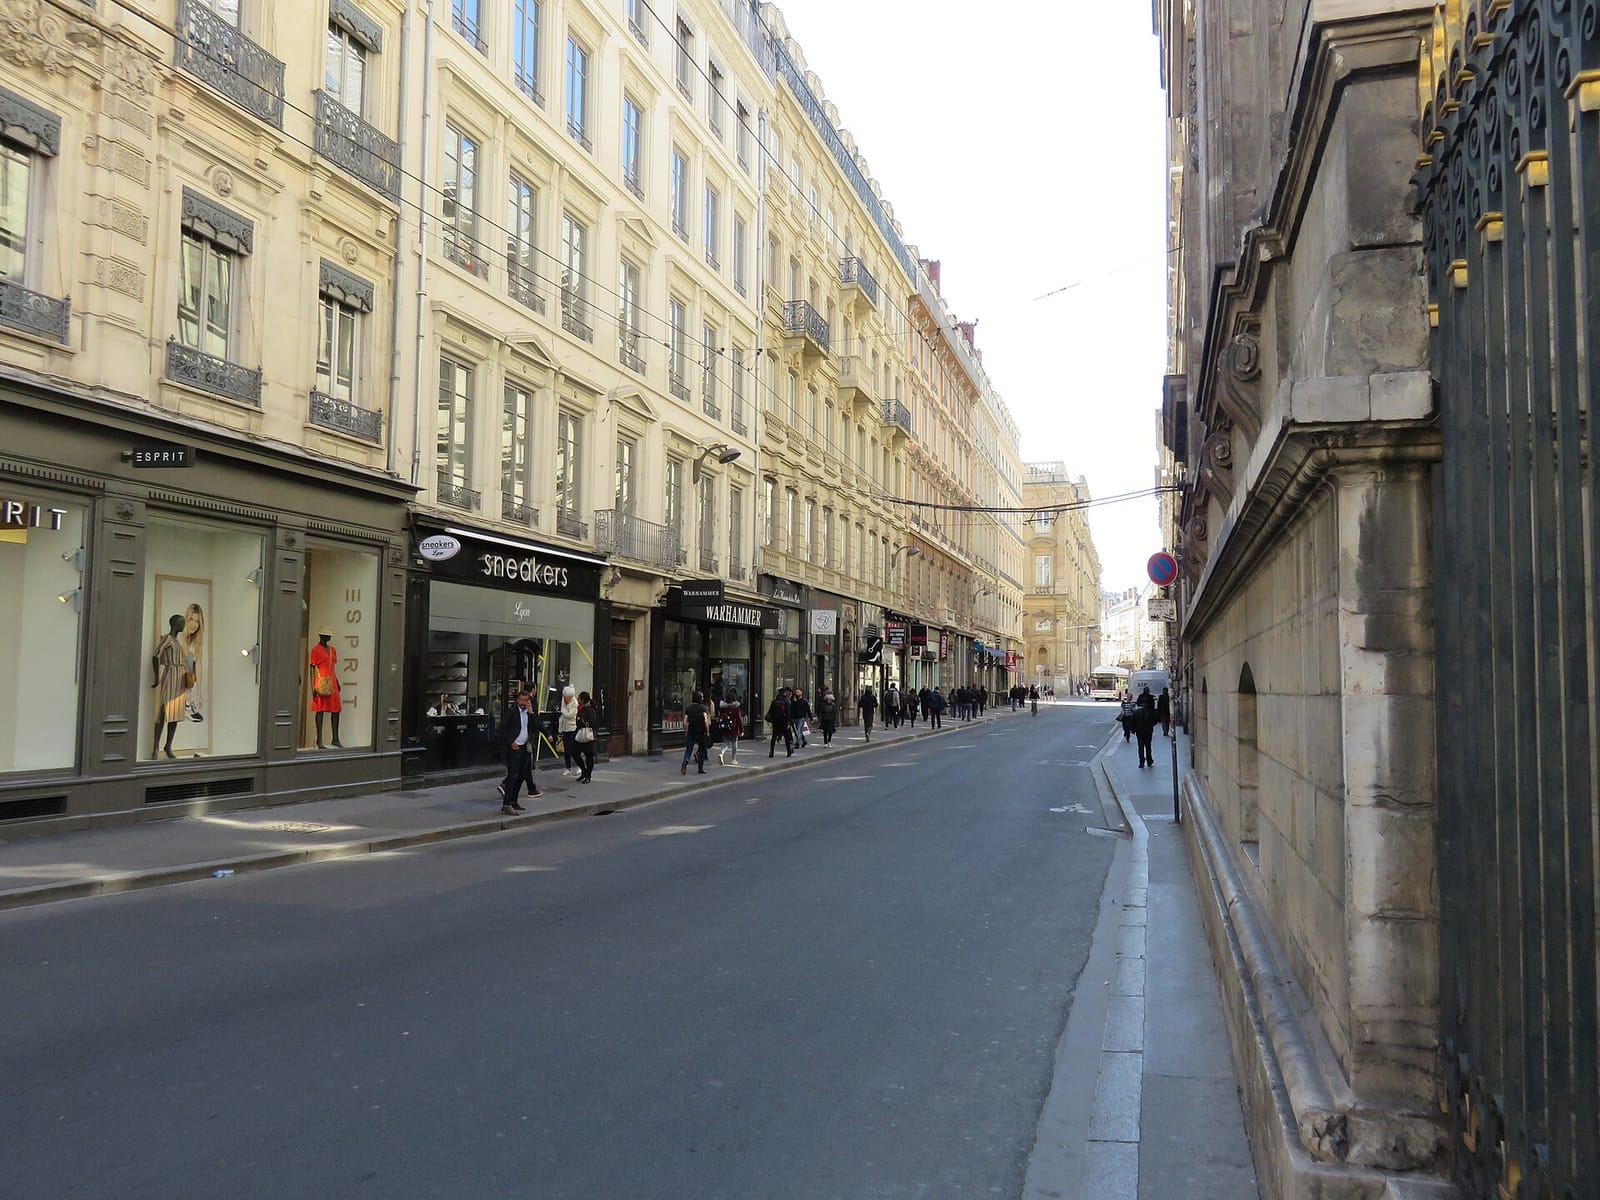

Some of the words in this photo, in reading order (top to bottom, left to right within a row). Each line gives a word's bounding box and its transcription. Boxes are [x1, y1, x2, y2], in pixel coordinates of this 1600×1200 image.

[136, 451, 184, 462] ESPRIT
[421, 540, 455, 549] sneakers
[484, 554, 568, 587] sneakers
[706, 605, 762, 627] WARHAMMER
[342, 589, 362, 708] ESPRIT
